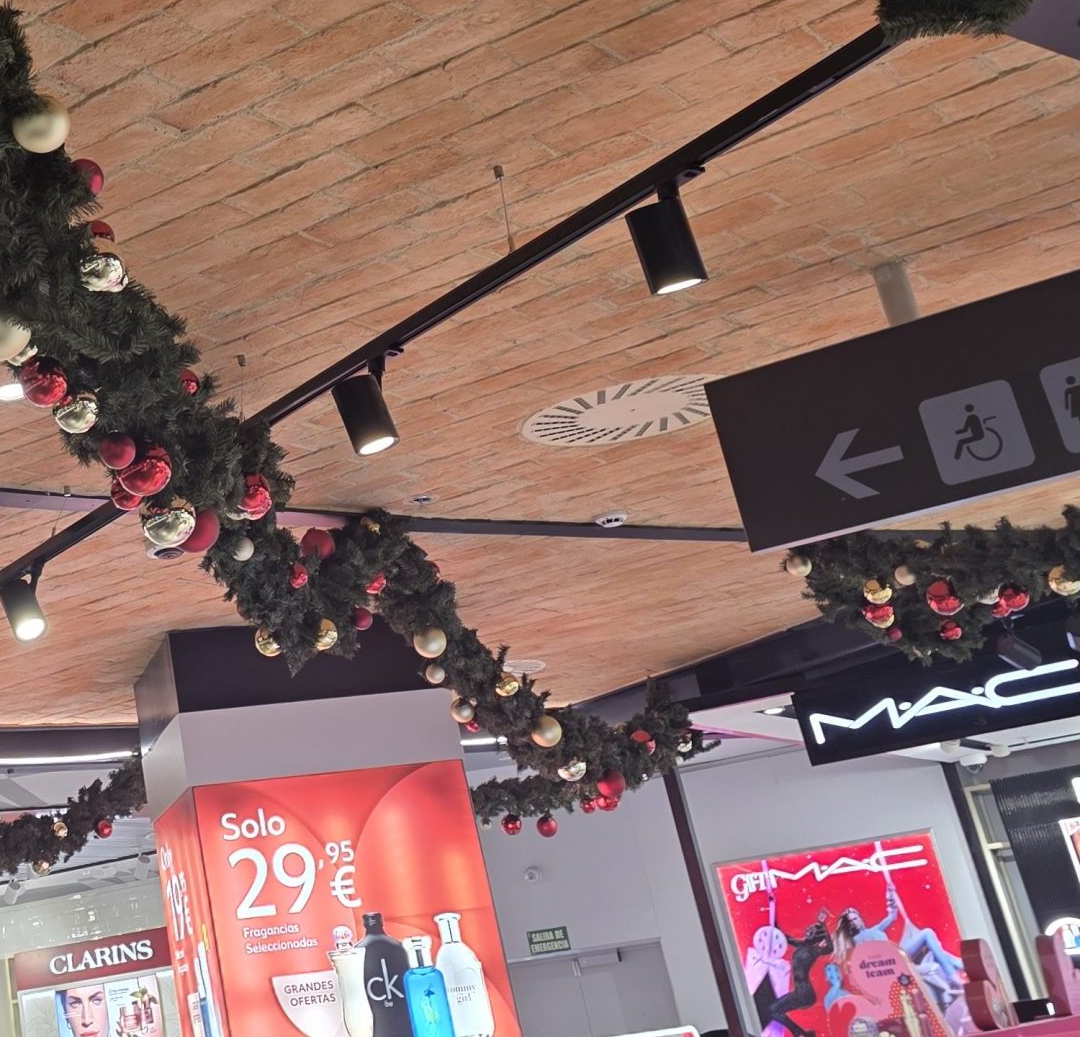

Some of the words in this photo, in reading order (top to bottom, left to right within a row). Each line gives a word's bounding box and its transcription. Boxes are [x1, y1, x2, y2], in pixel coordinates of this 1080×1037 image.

[221, 808, 286, 841] Solo
[243, 923, 299, 940] Fragancias
[246, 937, 318, 954] Seleccionadas
[49, 939, 154, 975] CLARINS
[859, 958, 896, 970] dream
[367, 958, 405, 1001] ck
[865, 968, 895, 979] team
[284, 980, 334, 995] GRANDES
[290, 993, 336, 1007] OFERTAS
